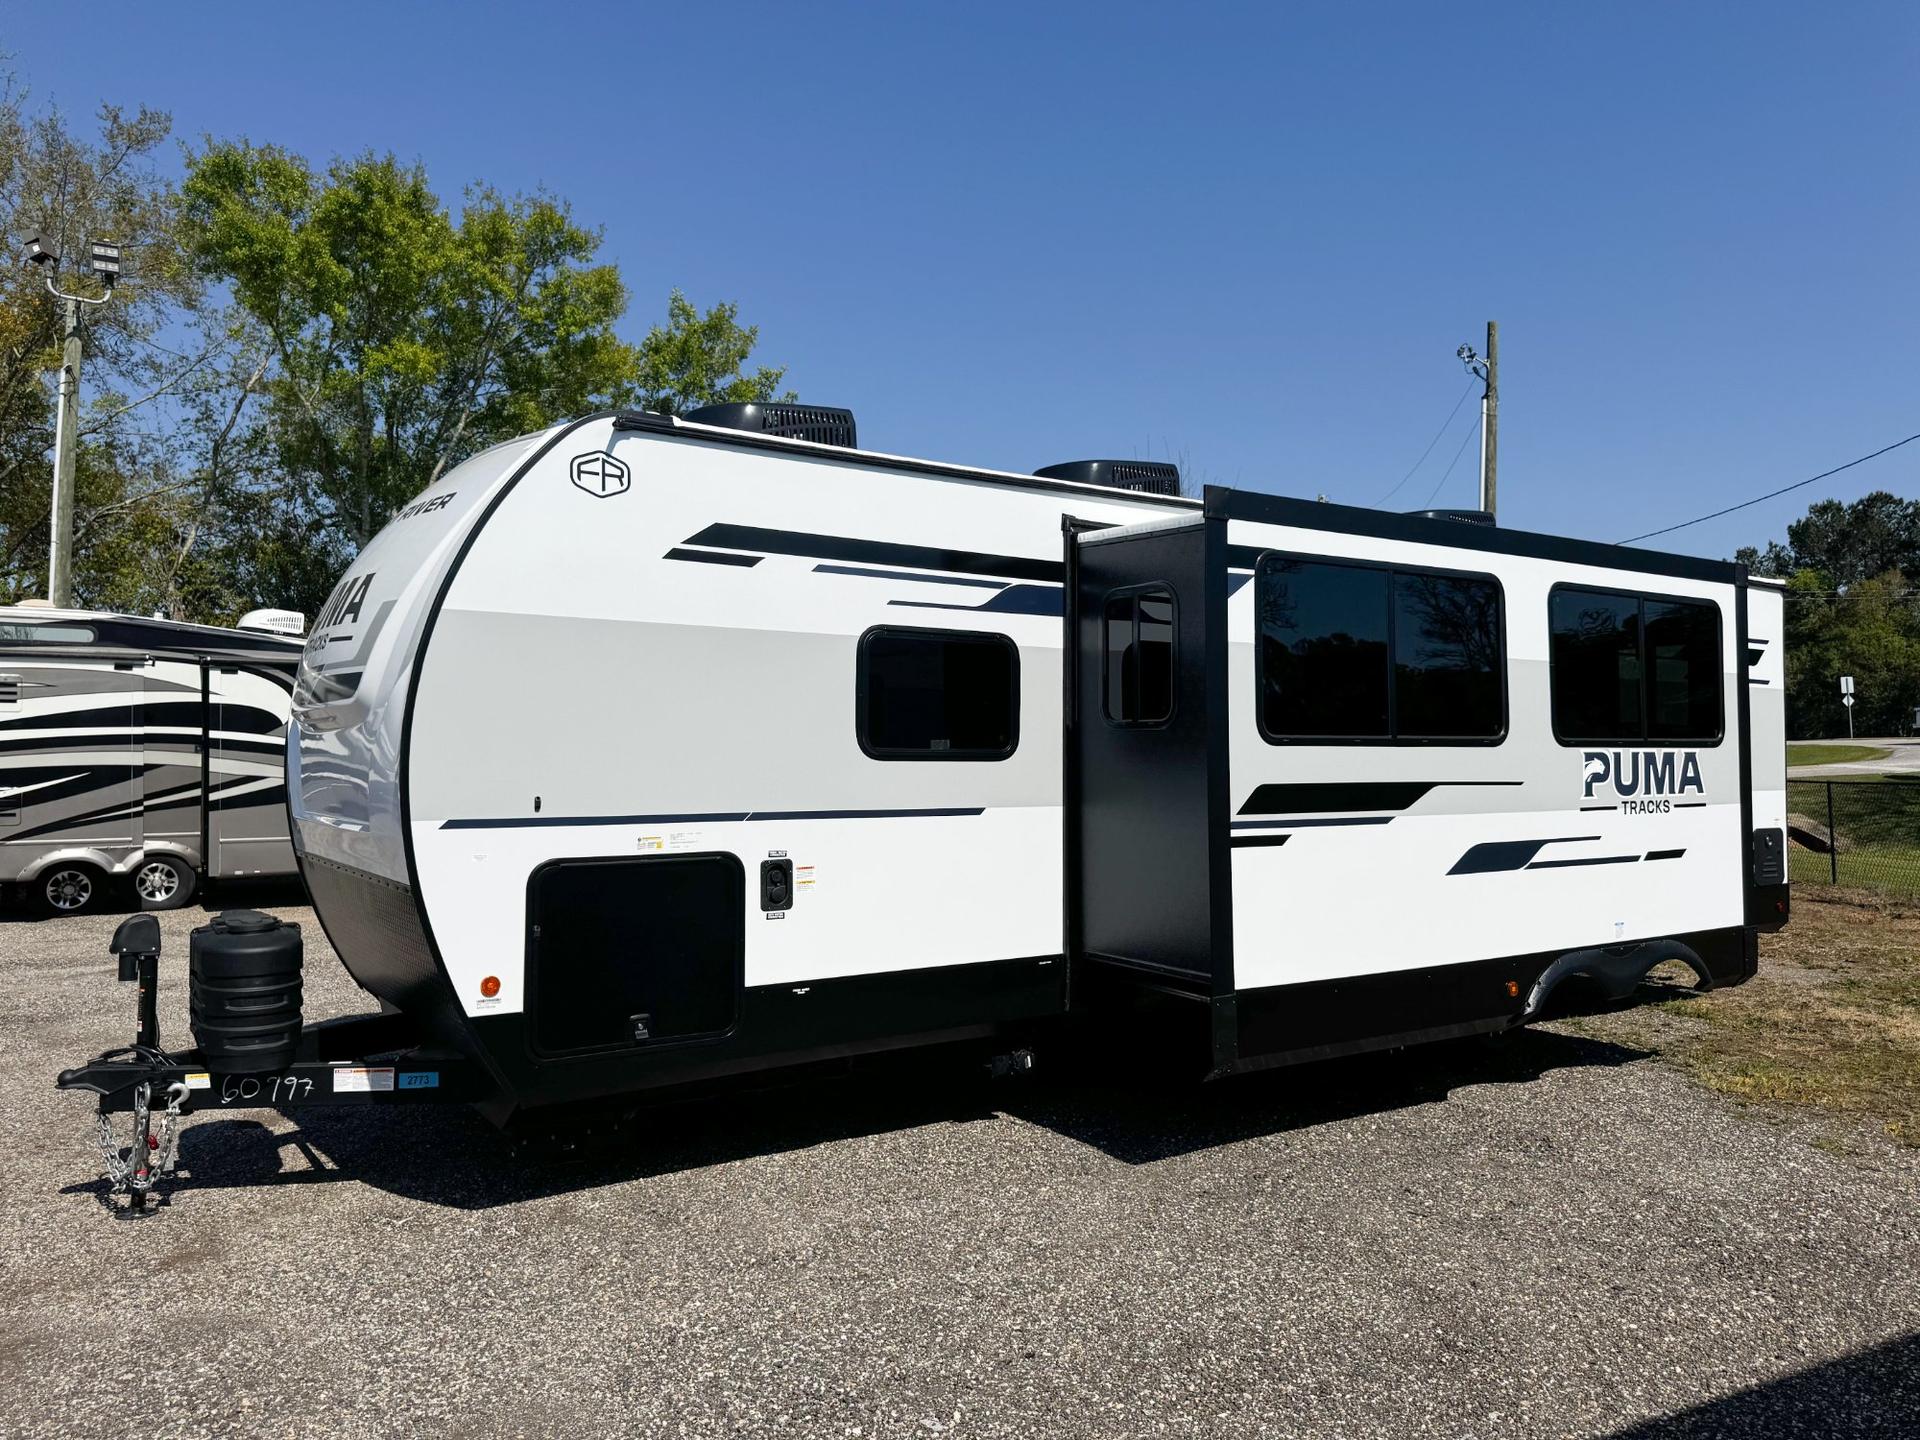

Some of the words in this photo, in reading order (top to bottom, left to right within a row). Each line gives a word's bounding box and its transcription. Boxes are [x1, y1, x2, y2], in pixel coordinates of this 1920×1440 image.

[1583, 751, 1705, 797] PUMA
[1621, 799, 1671, 815] TRACKS
[407, 1074, 430, 1086] 2773
